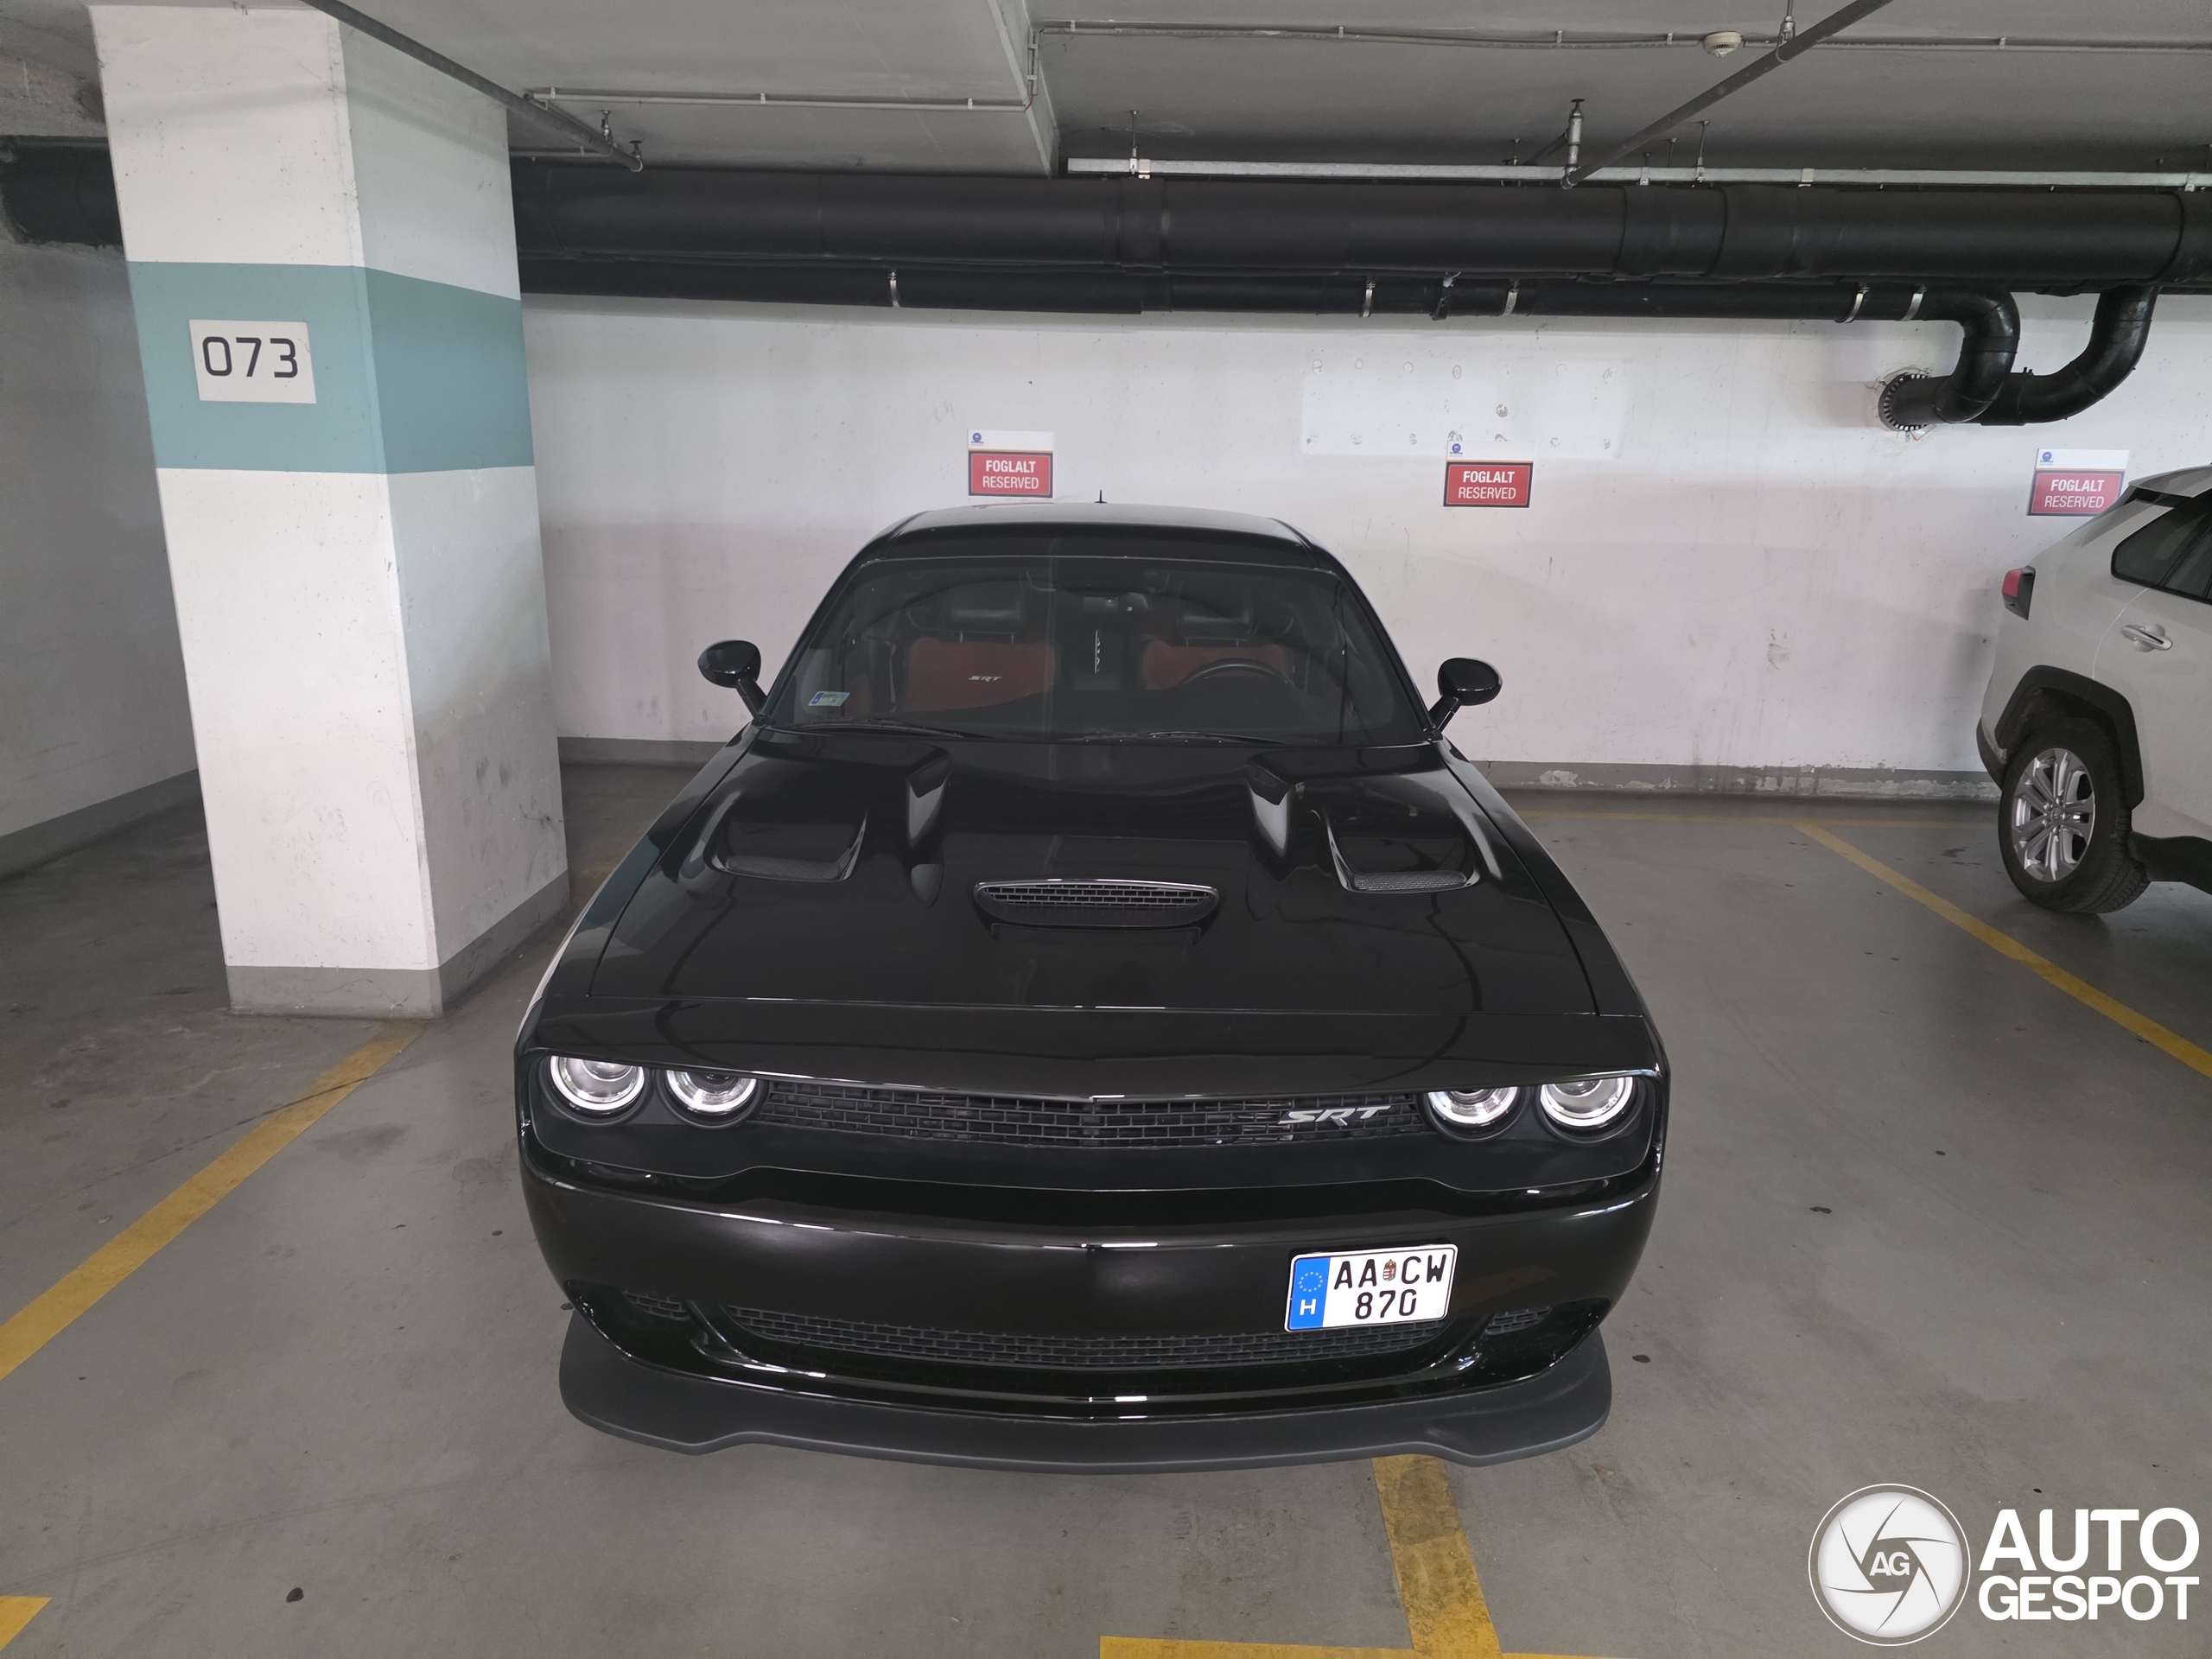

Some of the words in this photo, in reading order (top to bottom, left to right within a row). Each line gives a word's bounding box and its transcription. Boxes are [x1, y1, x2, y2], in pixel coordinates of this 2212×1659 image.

[202, 336, 298, 378] 073
[985, 460, 1036, 474] FOGLALT
[982, 475, 1039, 490] RESERVED
[1463, 470, 1516, 484] FOGLALT
[1458, 486, 1516, 499] RESERVED
[2050, 479, 2105, 492] FOGLALT
[2044, 495, 2105, 508] RESERVED
[1278, 1105, 1391, 1127] SRT
[1333, 1258, 1377, 1290] AA
[1401, 1254, 1447, 1285] CW
[1299, 1298, 1317, 1316] H
[1355, 1288, 1417, 1320] 870
